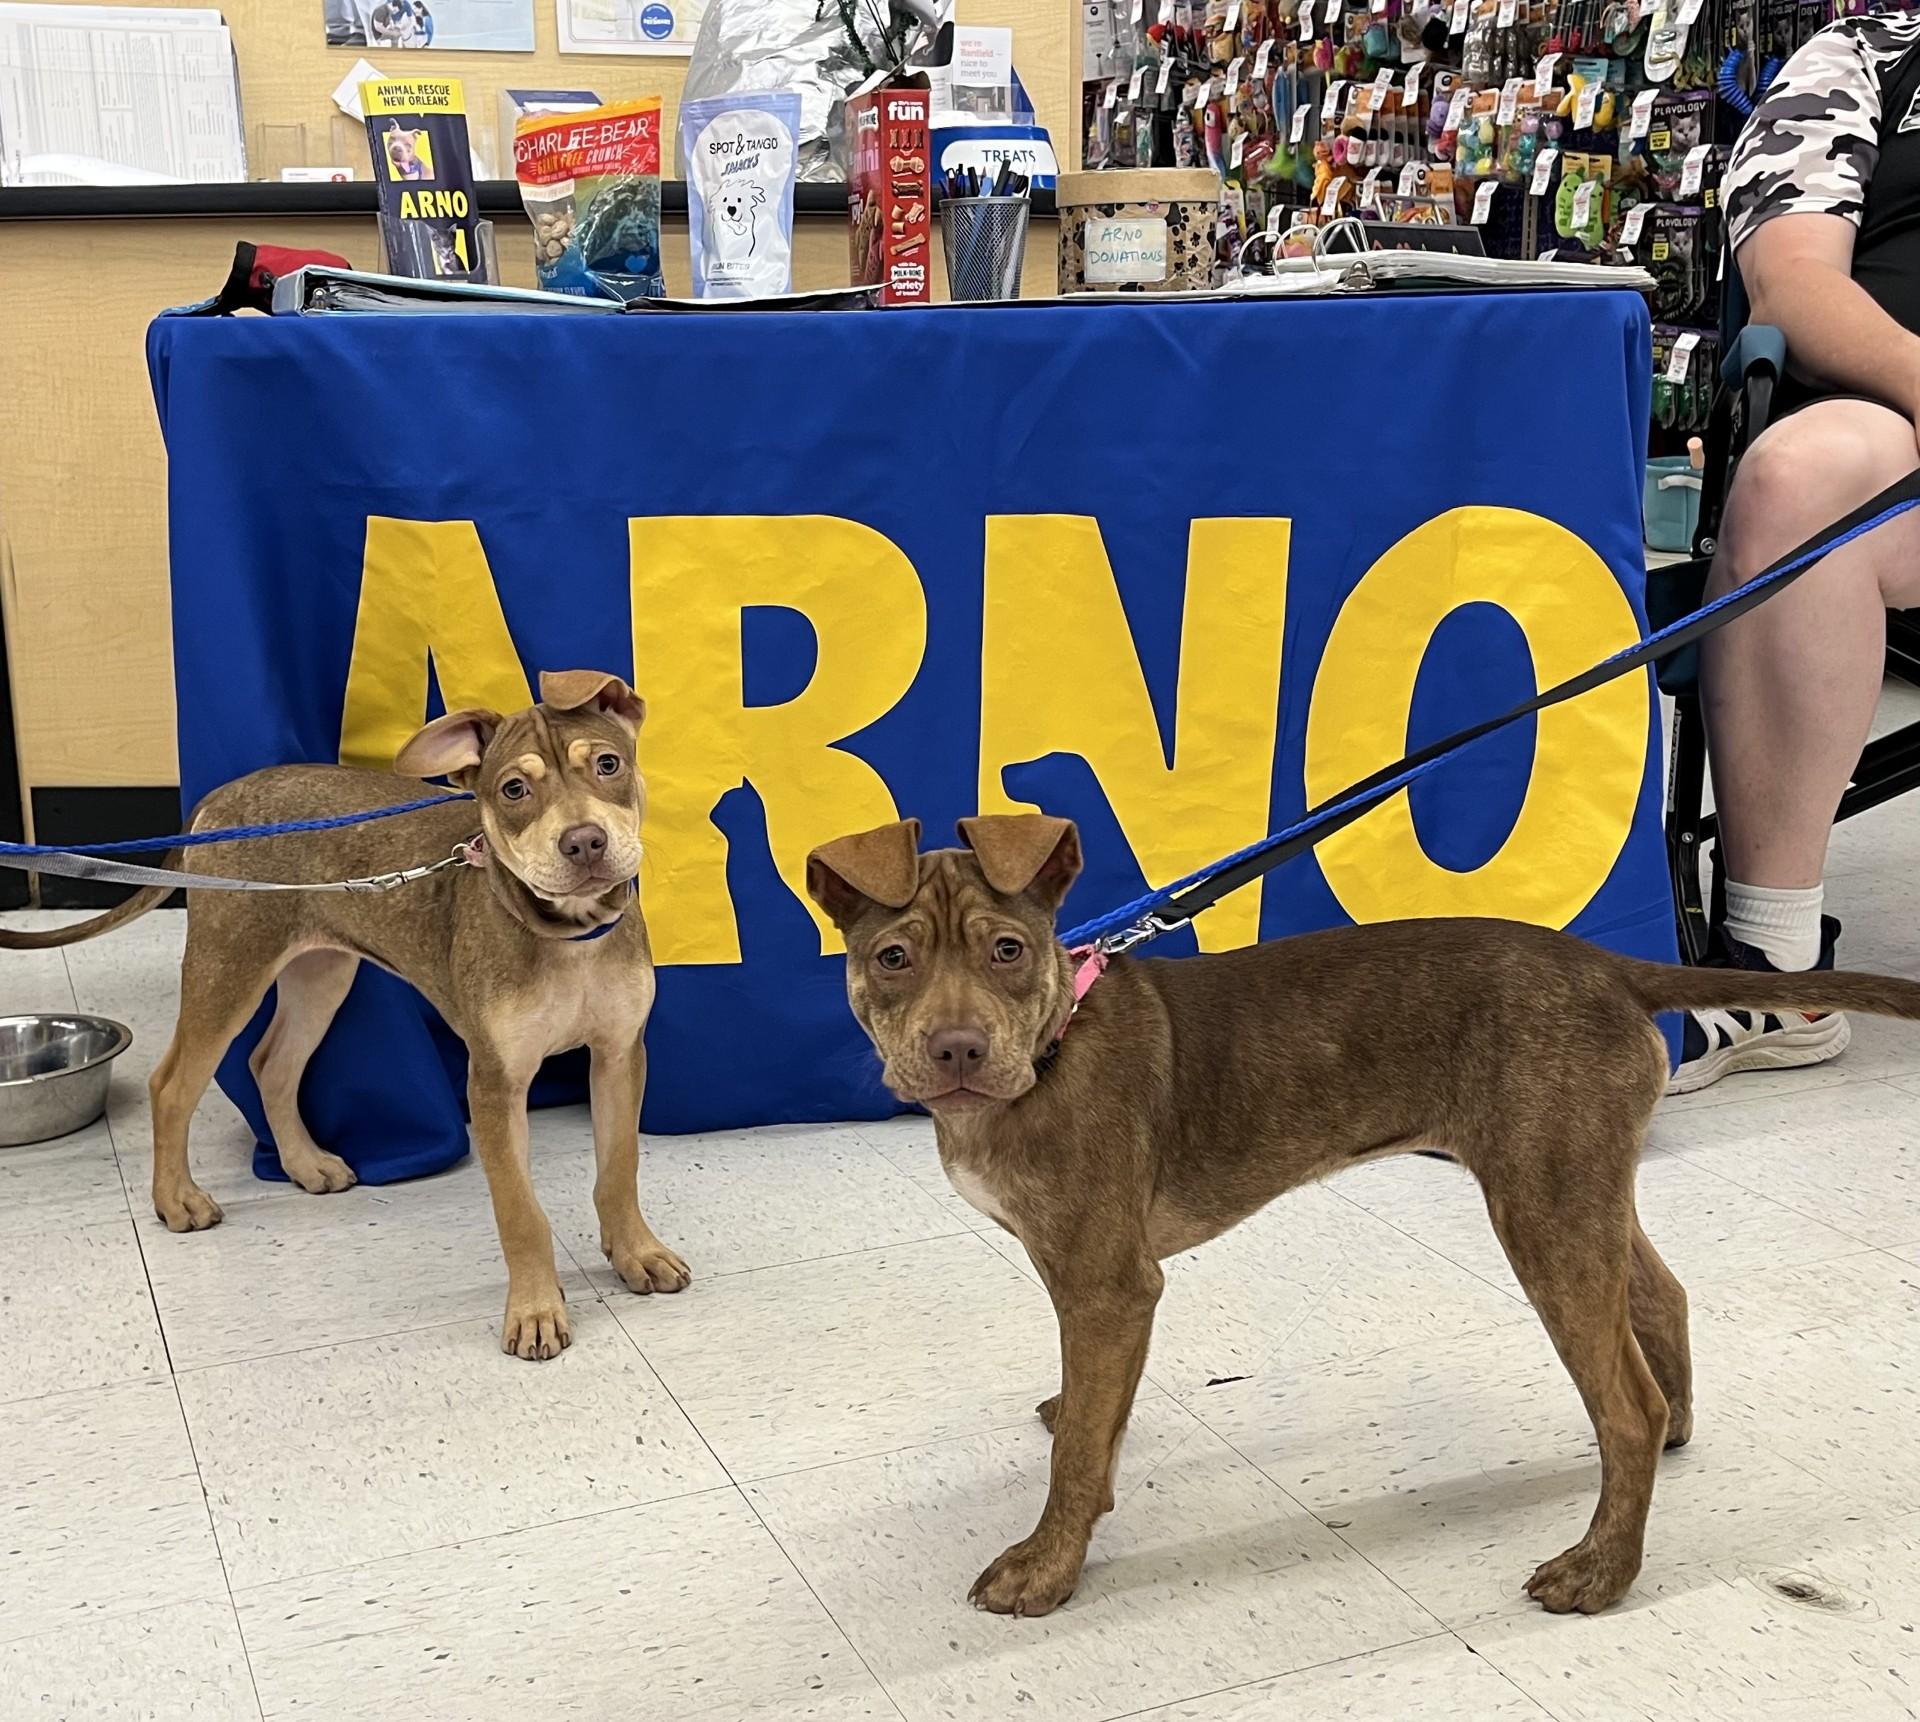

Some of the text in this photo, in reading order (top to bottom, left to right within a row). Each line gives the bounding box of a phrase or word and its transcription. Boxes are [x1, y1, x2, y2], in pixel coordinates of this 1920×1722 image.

[960, 60, 988, 68] nice to
[960, 69, 998, 79] meet you
[377, 85, 450, 96] ANIMAL RESCUE
[383, 96, 449, 107] NEW ORLEANS
[1654, 101, 1707, 116] PLAYOLOGY
[888, 100, 925, 121] fun
[599, 117, 650, 146] BEAR
[708, 133, 779, 156] SPOT & TANGO
[981, 149, 1037, 164] TREATS
[720, 152, 761, 177] SNACKS
[400, 190, 469, 219] ARNO
[1655, 216, 1698, 228] PLAYOLOGY
[1100, 227, 1143, 243] ARNO
[1088, 250, 1163, 265] DONATIONS
[891, 280, 925, 292] variety
[339, 504, 1650, 966] ARNO
